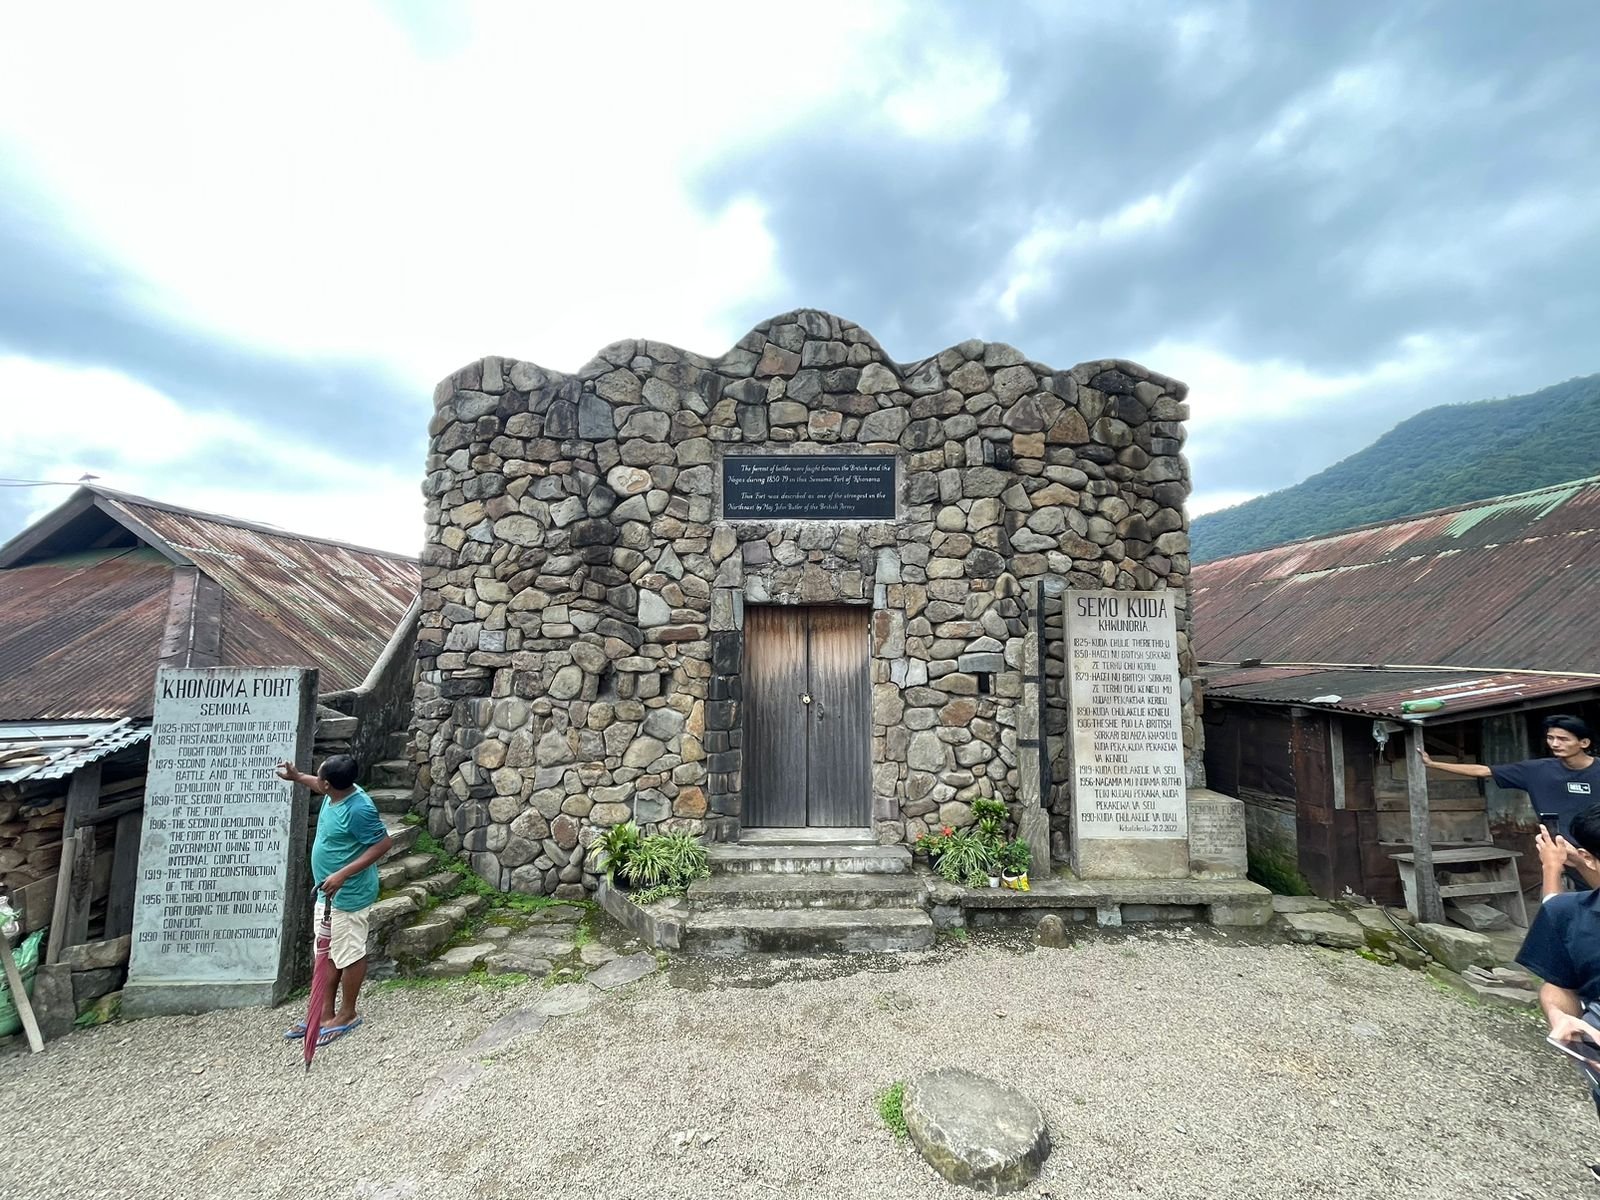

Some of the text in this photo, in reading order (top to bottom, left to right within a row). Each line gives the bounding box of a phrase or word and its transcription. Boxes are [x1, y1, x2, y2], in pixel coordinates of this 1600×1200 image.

[770, 465, 775, 474] of
[845, 475, 852, 484] of
[828, 492, 834, 501] of
[756, 503, 762, 511] by
[804, 503, 809, 512] of
[1078, 598, 1167, 618] SEMO KUDA
[162, 678, 294, 698] KHONOMA FORT
[200, 703, 250, 716] SEMOMA
[202, 723, 247, 733] COMPLETION
[249, 722, 258, 732] OF
[259, 722, 272, 732] THE
[1147, 720, 1172, 728] BRITISH
[267, 733, 293, 743] BATTLE
[178, 747, 205, 757] FOUGHT
[207, 746, 227, 756] FROM
[230, 746, 247, 755] THIS
[176, 770, 205, 780] BATTLE
[210, 769, 227, 779] AND
[233, 769, 247, 779] THE
[175, 783, 220, 793] DEMOLITION
[225, 781, 235, 792] OF
[240, 781, 254, 791] THE
[191, 794, 222, 804] SECOND
[172, 806, 224, 817] OF THE FORT
[188, 818, 218, 828] SECOND
[221, 817, 264, 828] DEMOLITION
[268, 817, 278, 827] OF
[171, 829, 272, 841] THE FORT BY THE BRITISH
[169, 841, 280, 854] GOVERNMENT OWING TO AN
[168, 854, 251, 866] INTERNAL CONFLICT
[185, 868, 207, 878] THIRD
[210, 866, 277, 877] RECONSTRUCTION
[166, 880, 218, 891] OF THE FORT
[181, 893, 203, 903] THIRD
[205, 891, 249, 902] DEMOLITION
[252, 891, 262, 900] OF
[263, 890, 278, 900] THE
[164, 903, 278, 917] FORT DURING THE INDO NAGA
[162, 931, 179, 941] THE
[180, 930, 210, 940] FOURTH
[213, 928, 278, 939] RECONSTRUCTION
[161, 944, 172, 954] OF
[177, 943, 189, 953] THE
